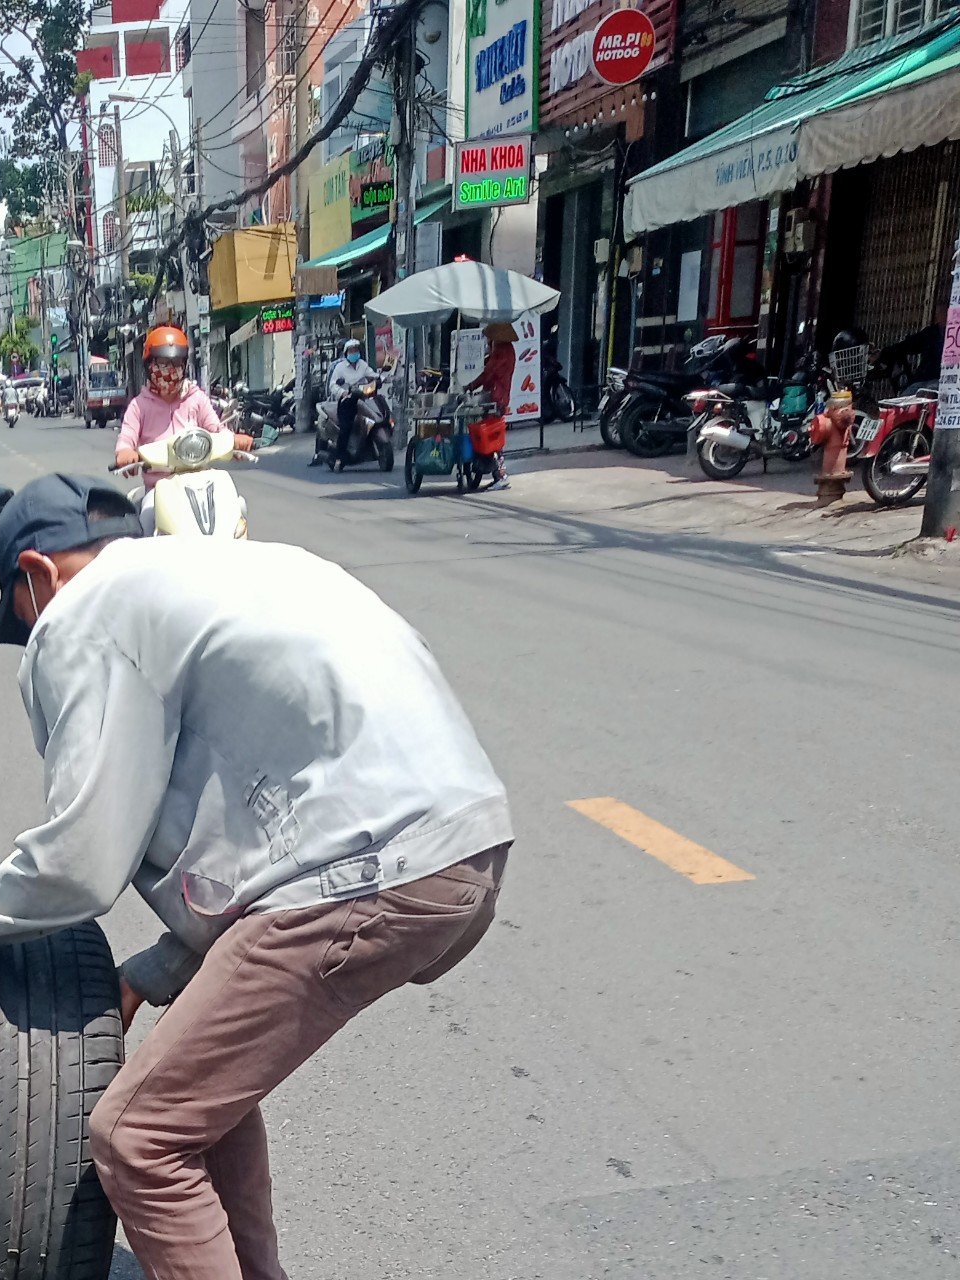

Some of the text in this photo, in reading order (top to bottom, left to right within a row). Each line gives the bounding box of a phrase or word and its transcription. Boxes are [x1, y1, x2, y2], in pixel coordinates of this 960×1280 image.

[596, 47, 640, 62] HOTDOG
[461, 144, 523, 173] NHA KHOA
[459, 176, 526, 202] Smile Art
